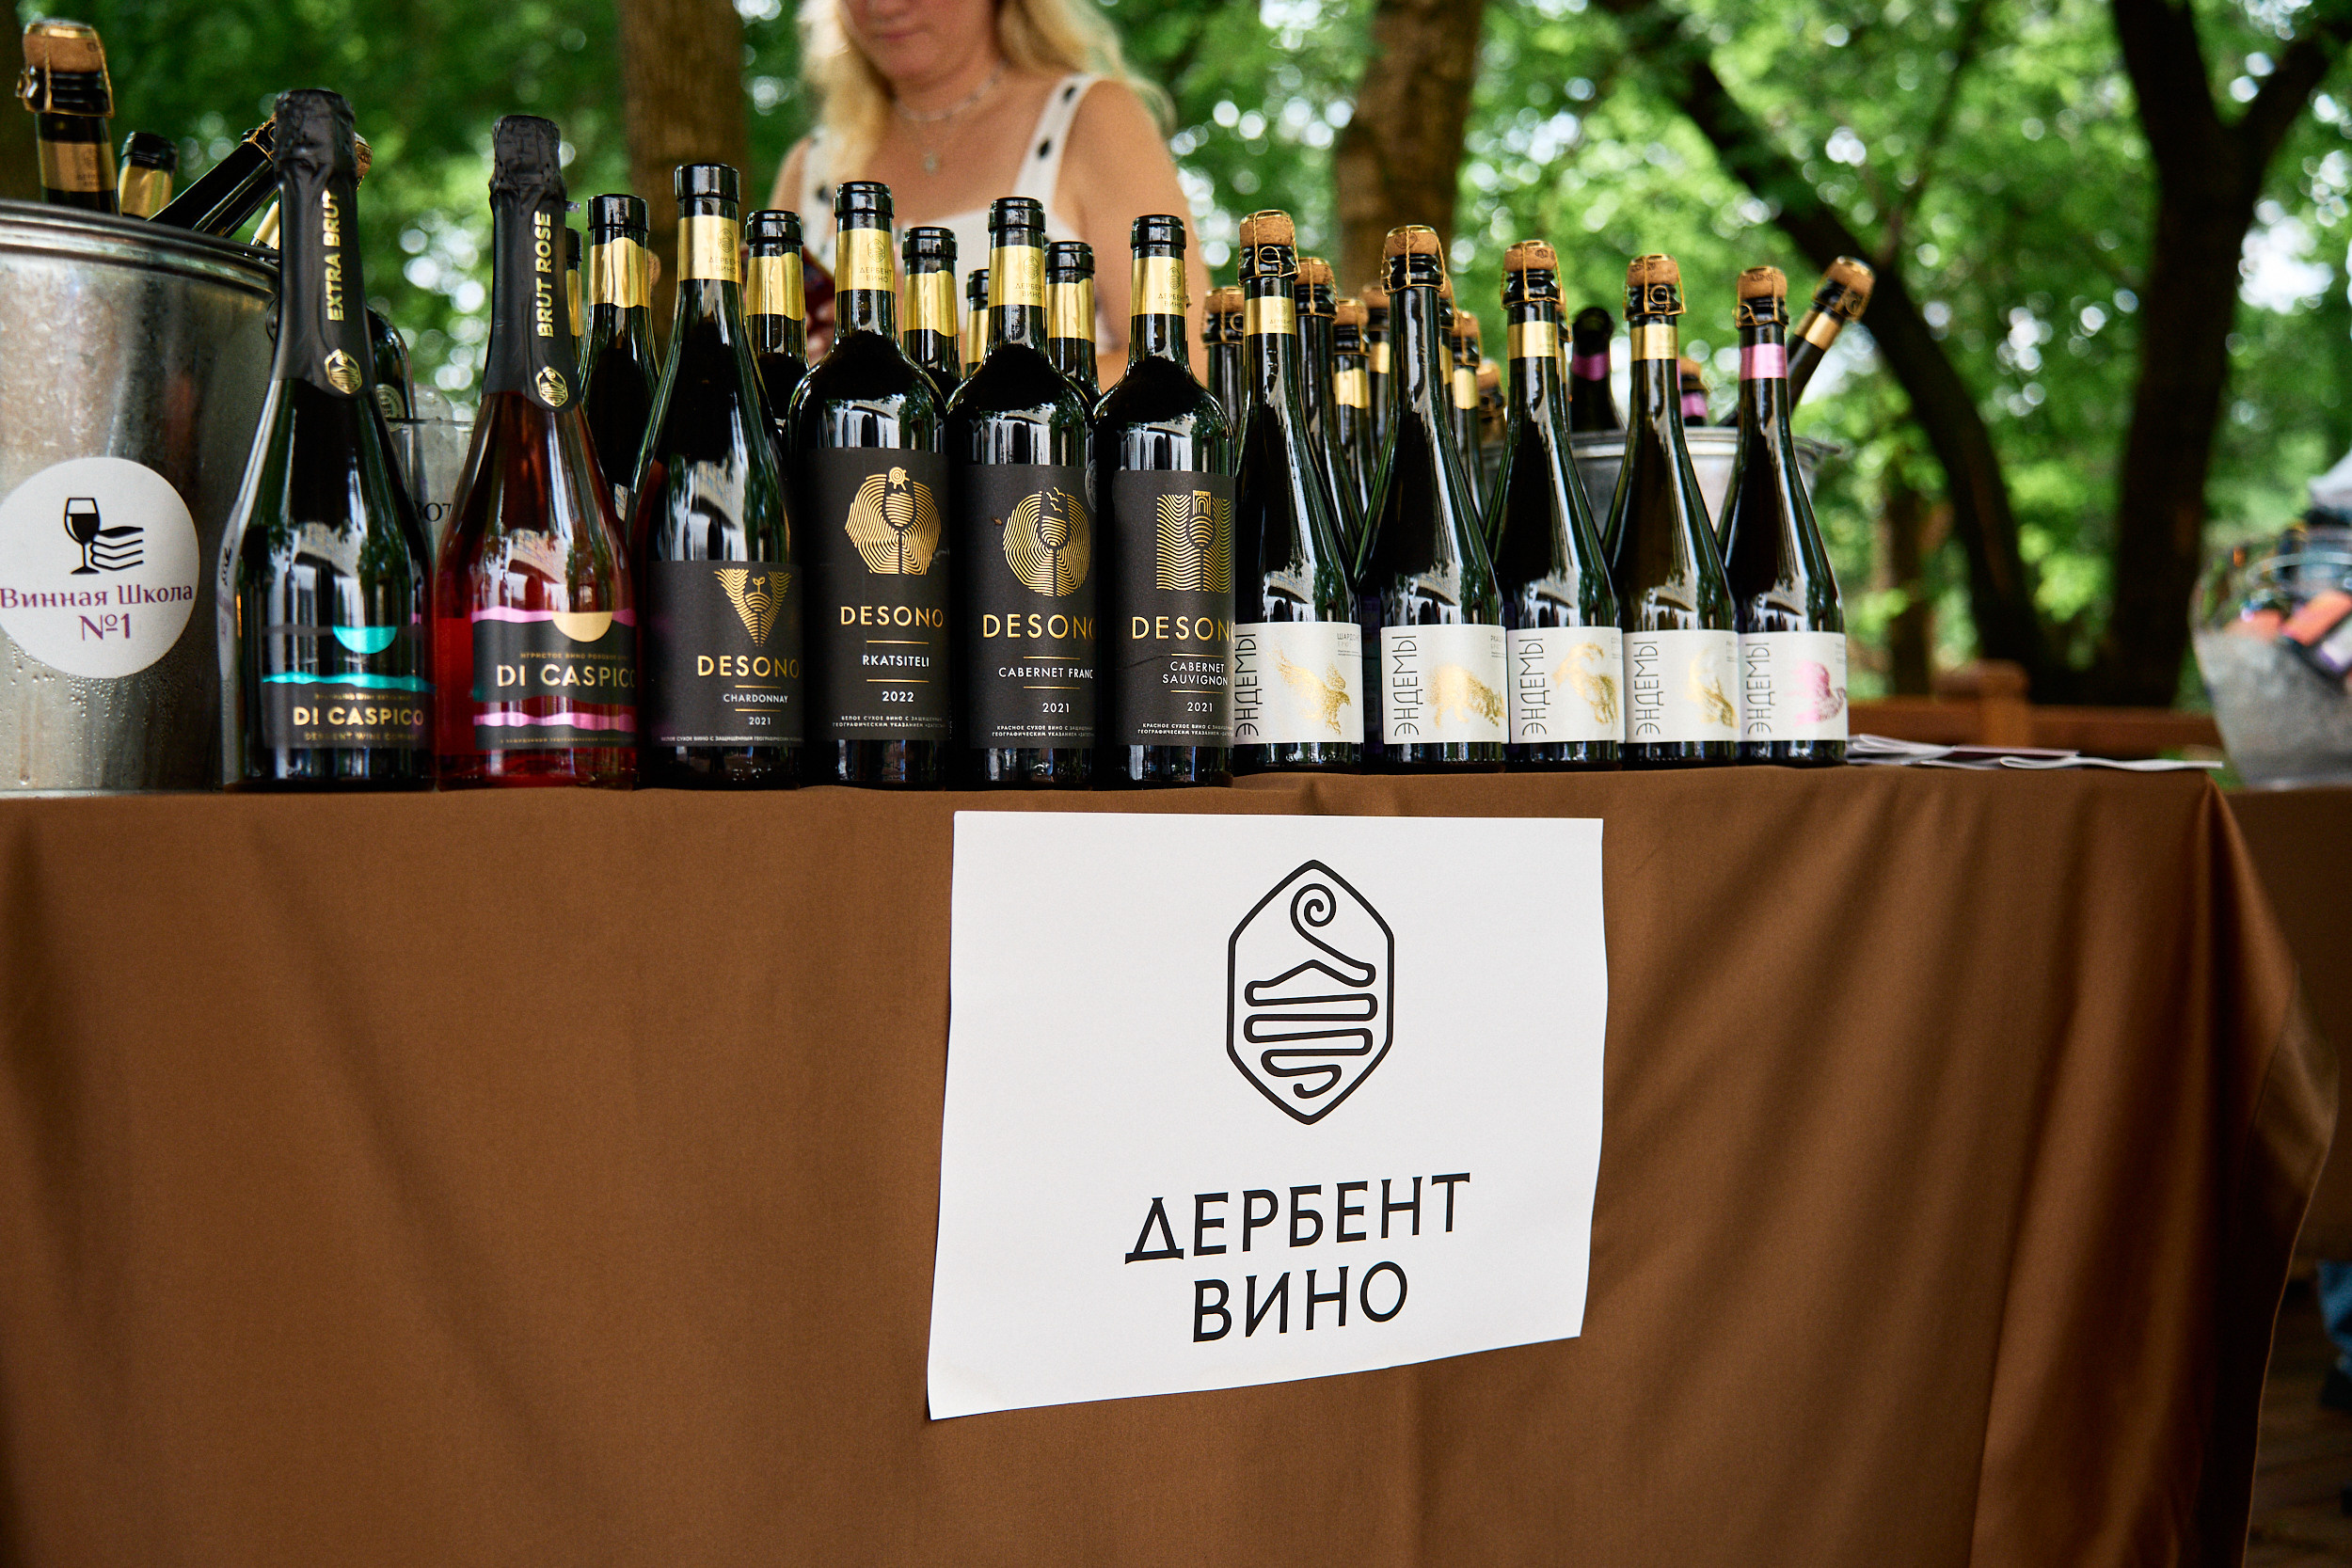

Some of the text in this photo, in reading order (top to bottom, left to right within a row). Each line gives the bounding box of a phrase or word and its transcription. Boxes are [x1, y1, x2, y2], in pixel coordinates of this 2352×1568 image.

[322, 189, 344, 322] EXTRA BRUT
[533, 210, 554, 338] BRUT ROSE
[0, 584, 193, 610] Винная Школа
[78, 612, 131, 641] №1
[840, 605, 945, 628] DESONO
[697, 655, 800, 679] DESONO
[862, 655, 930, 668] RKATSITELI
[998, 667, 1064, 677] CABERNET
[1169, 661, 1225, 673] CABERNET
[497, 664, 526, 688] DI
[1162, 673, 1228, 686] SAUVIGNON
[1235, 633, 1263, 737] ЭНДЕМЫ
[1391, 635, 1423, 736] ЭНДЕМЫ
[1518, 638, 1550, 736] ЭНДЕМЫ
[723, 693, 788, 704] CHARDONNAY
[882, 690, 914, 703] 2022
[1632, 641, 1664, 736] ЭНДЕМЫ
[1745, 642, 1775, 736] ЭНДЕМЫ
[293, 705, 424, 726] DI CASPICO
[1042, 703, 1071, 713] 2021
[1187, 702, 1214, 713] 2021
[748, 716, 771, 725] 2021
[1124, 1172, 1470, 1265] ДЕРБЕНТ
[1193, 1260, 1408, 1343] ВИНО
